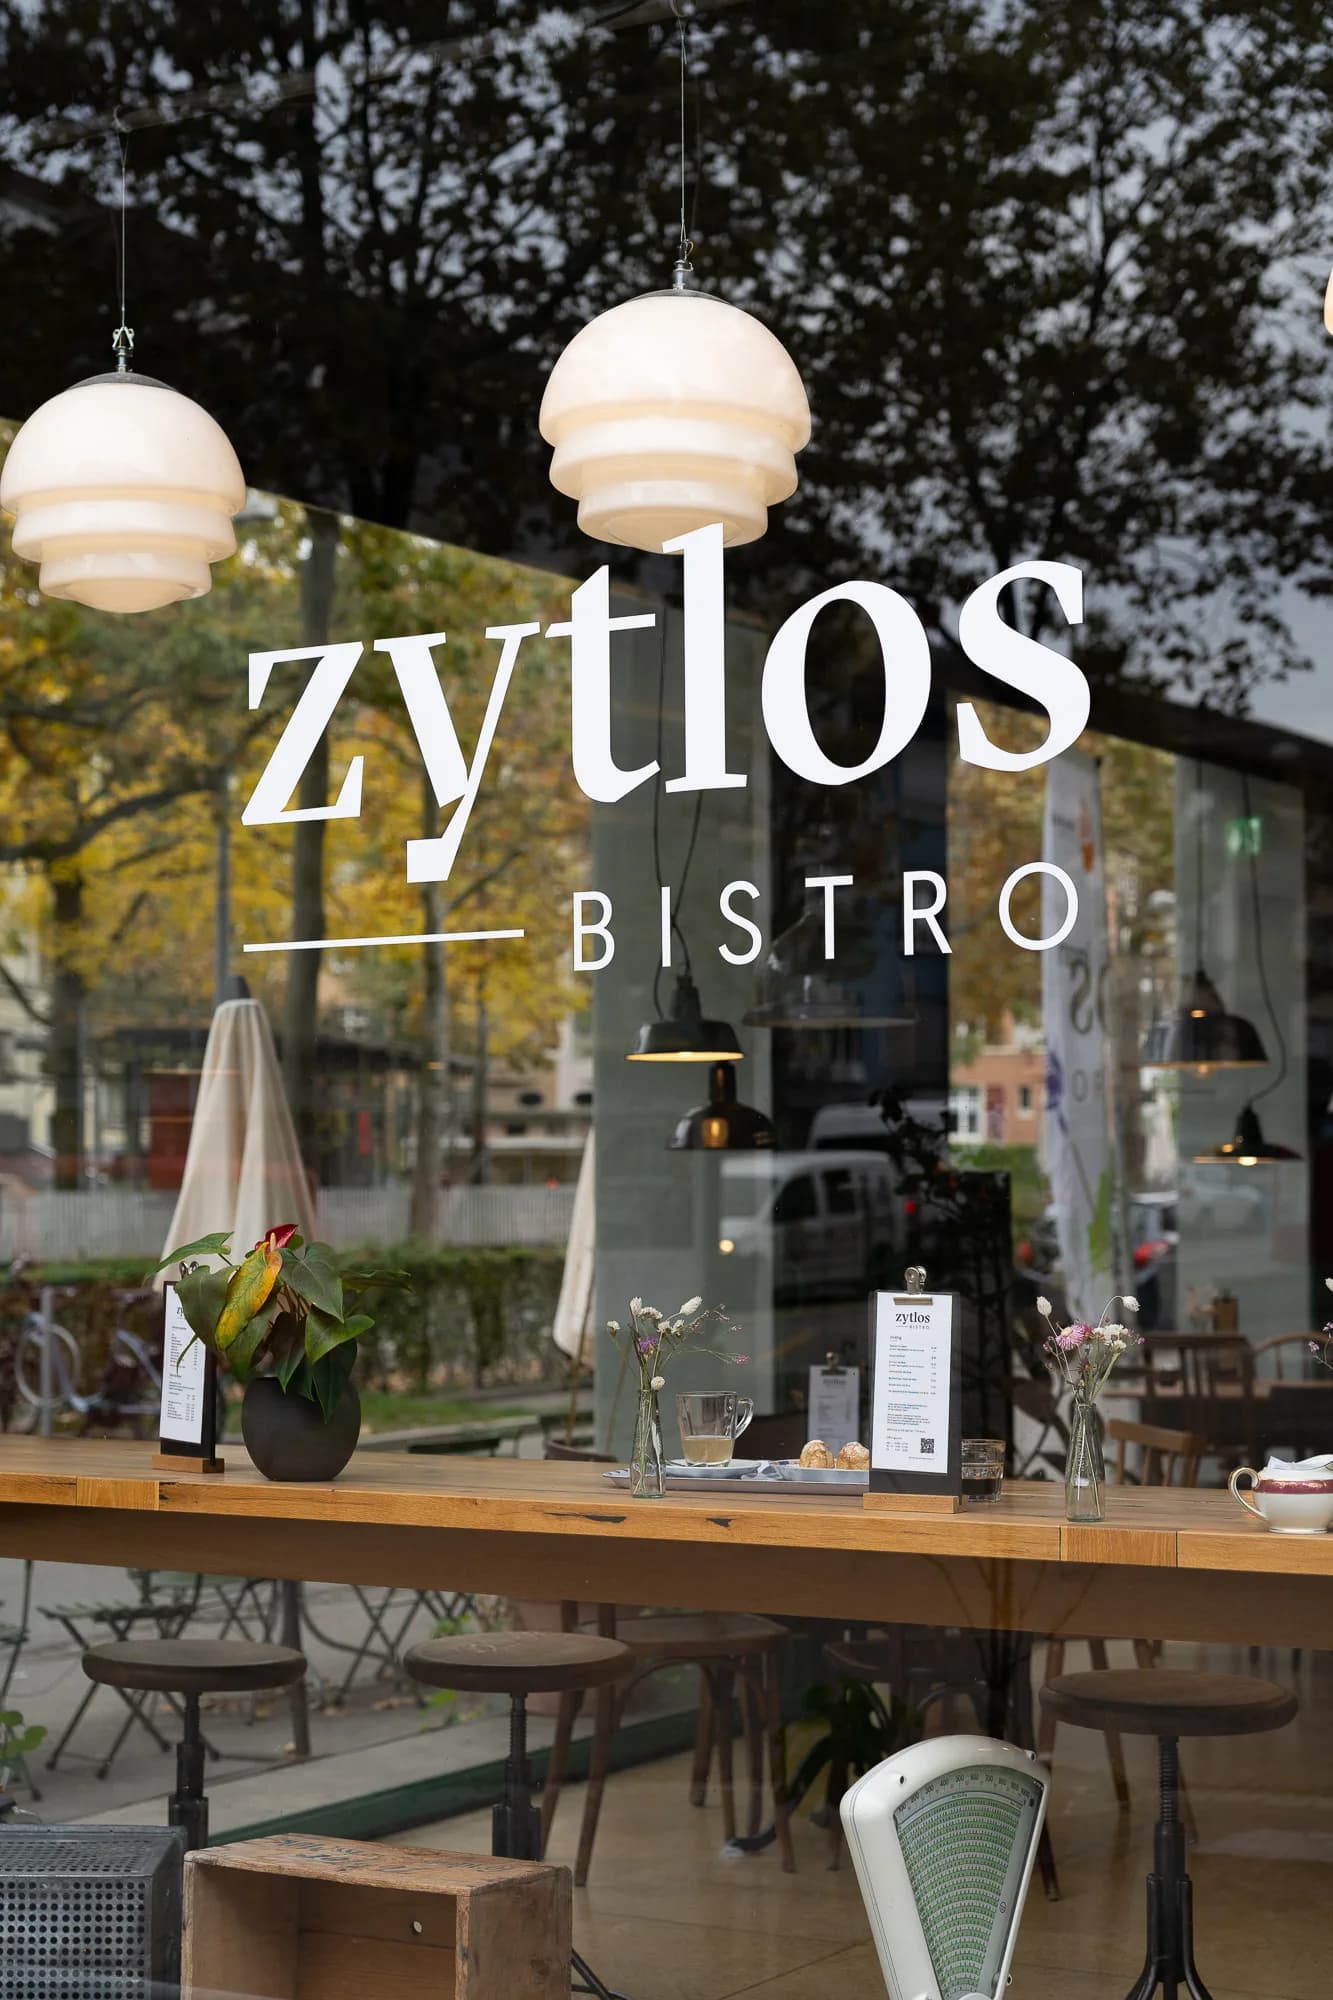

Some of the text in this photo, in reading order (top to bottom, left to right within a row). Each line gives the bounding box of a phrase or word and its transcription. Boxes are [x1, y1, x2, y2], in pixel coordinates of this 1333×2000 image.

[241, 523, 1092, 884] zytlos
[573, 861, 1080, 972] BISTRO
[895, 1311, 931, 1325] zytlos
